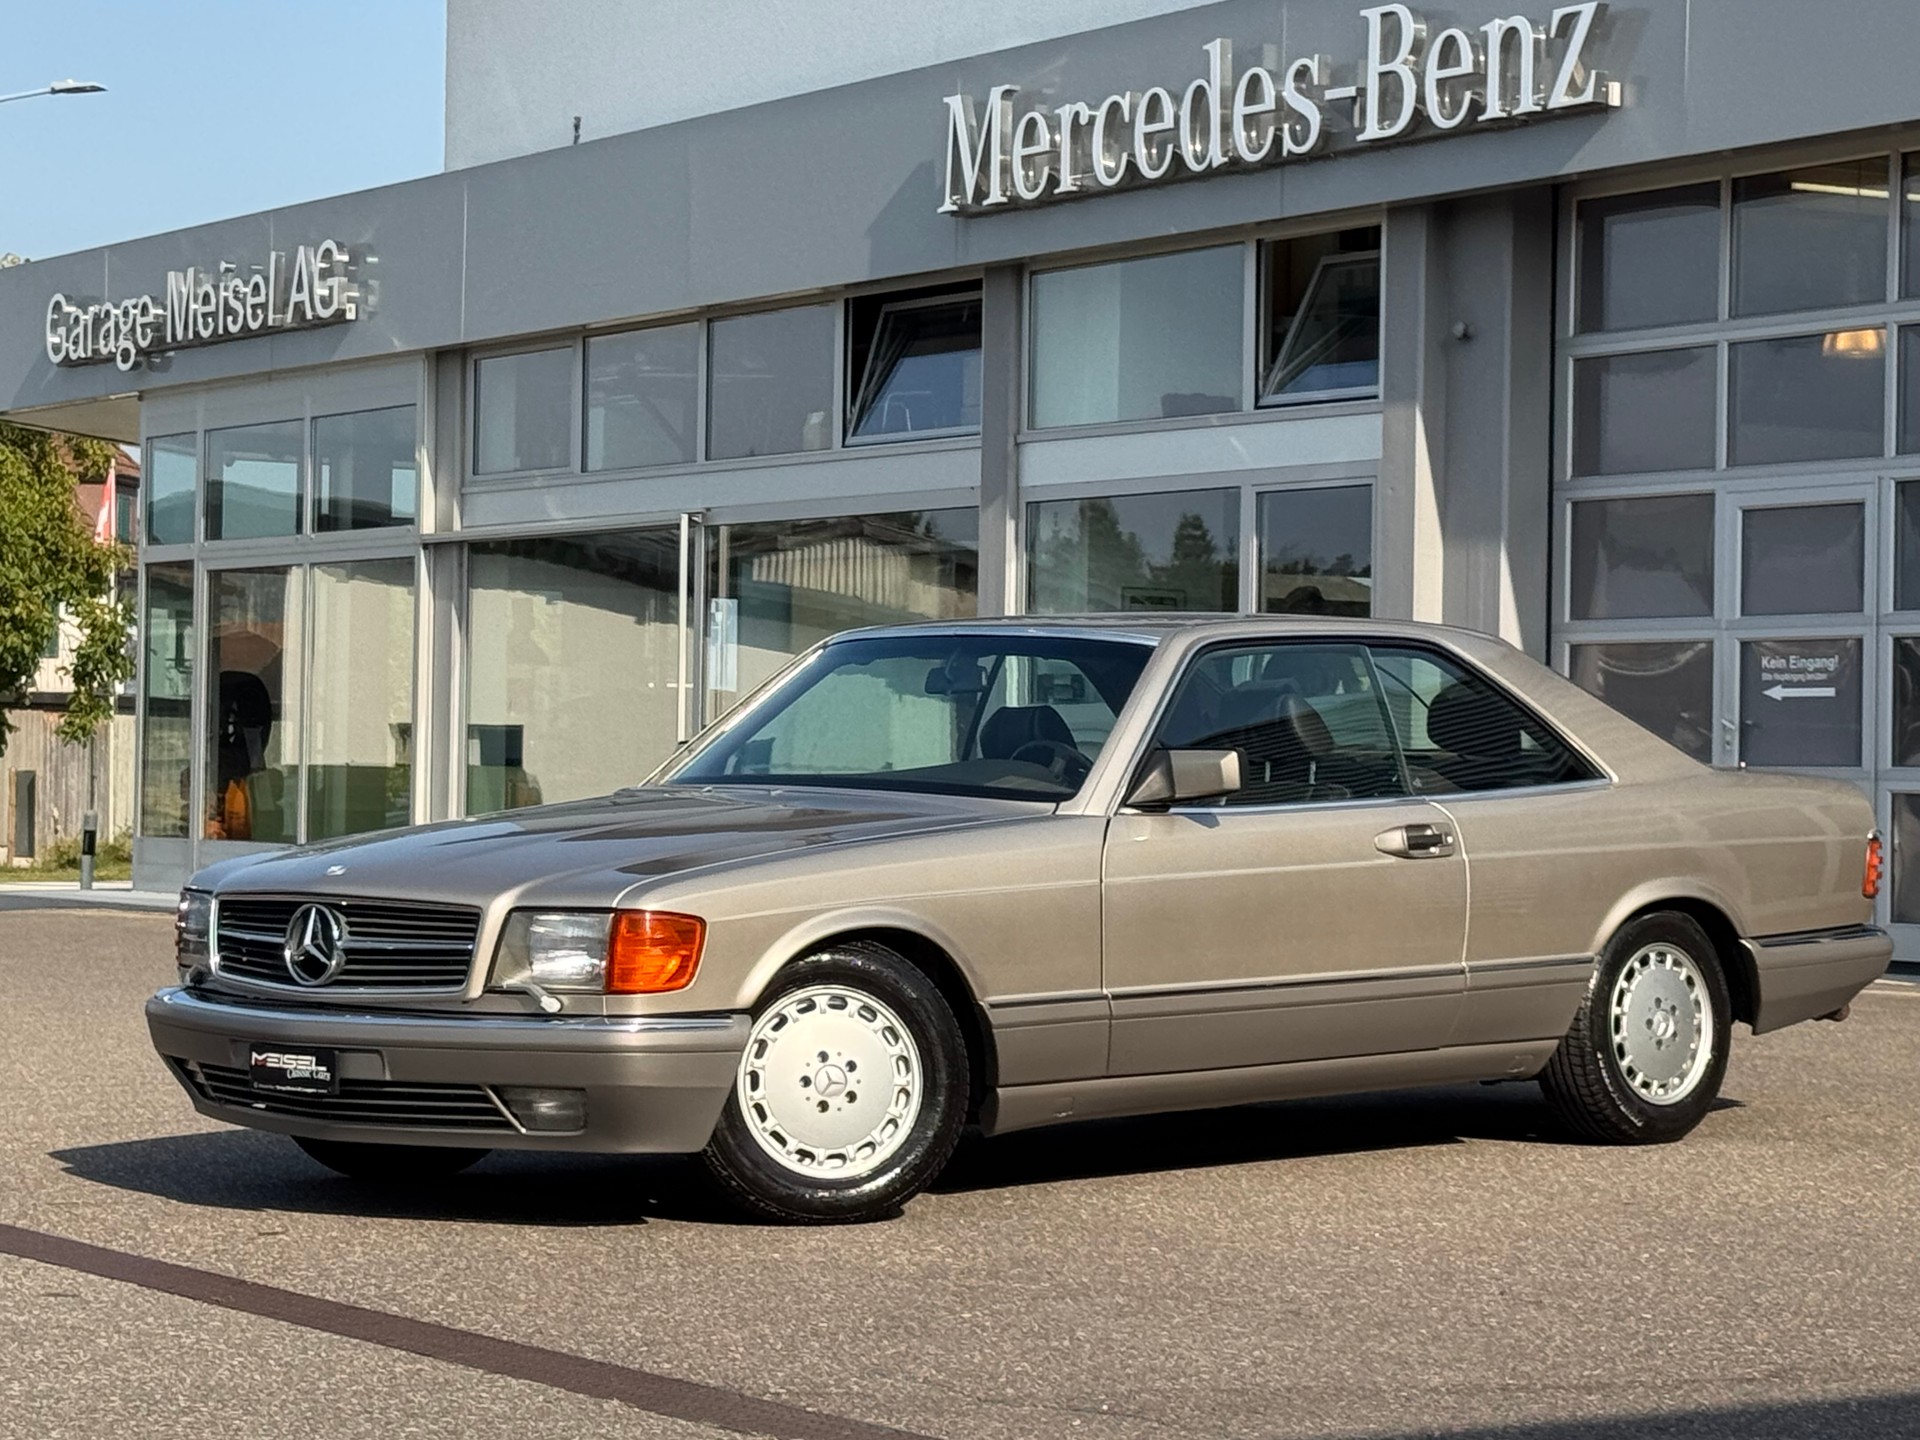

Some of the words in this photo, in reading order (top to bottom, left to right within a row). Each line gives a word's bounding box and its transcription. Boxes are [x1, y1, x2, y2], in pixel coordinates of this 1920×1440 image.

[937, 1, 1604, 215] Mercedes-Benz
[46, 293, 154, 371] Garage
[166, 250, 280, 344] Meisel
[286, 239, 349, 324] AG
[1761, 655, 1787, 669] Kein
[1788, 654, 1839, 672] Eingang!
[251, 1051, 328, 1071] MEISEL
[312, 1068, 331, 1082] Cars
